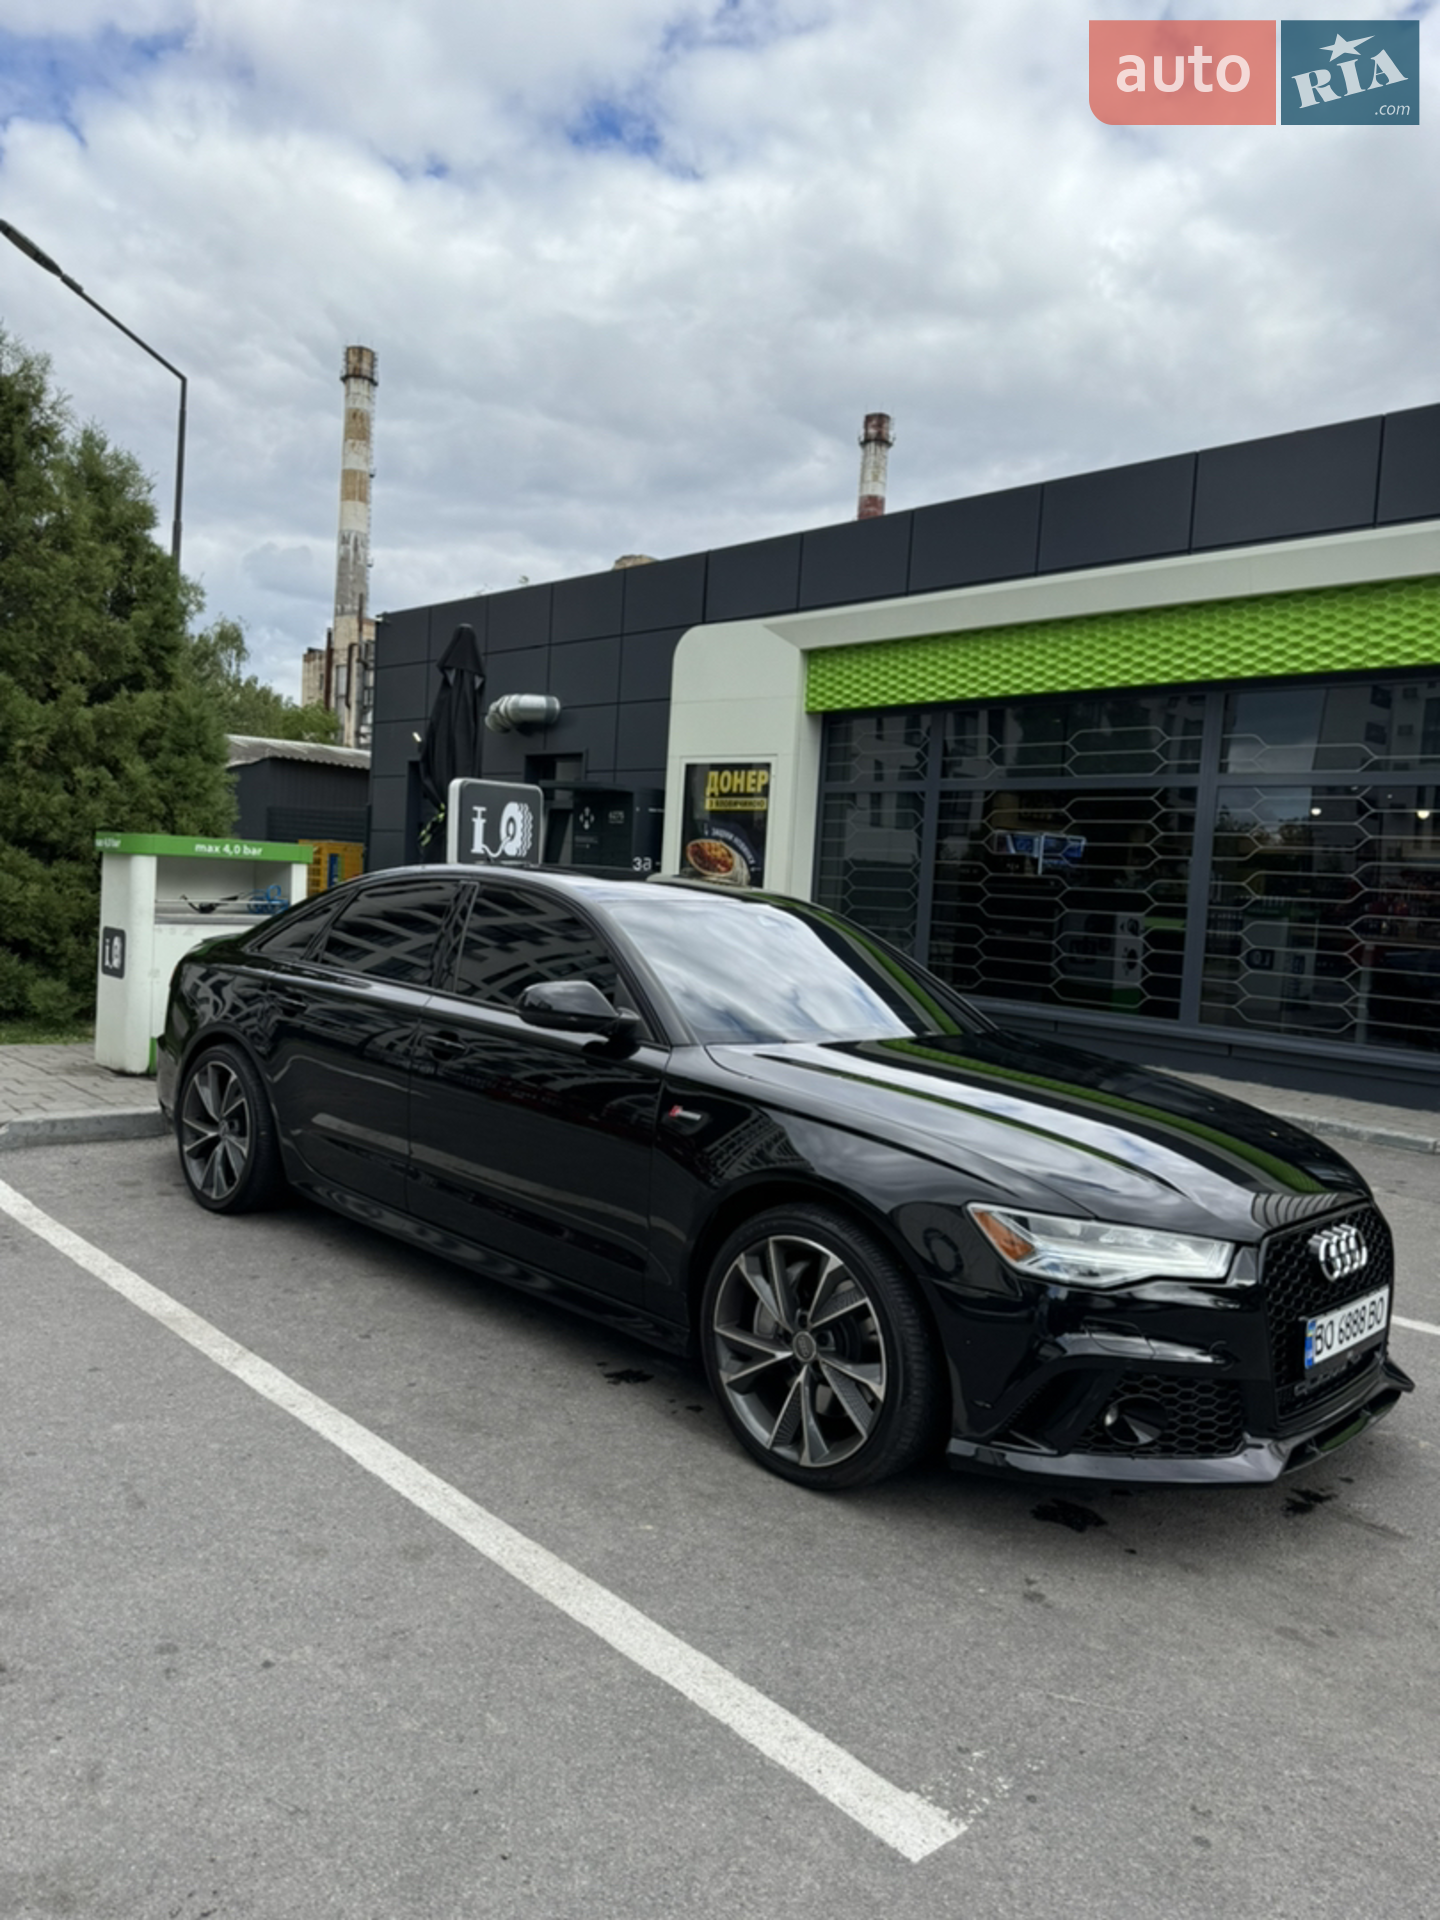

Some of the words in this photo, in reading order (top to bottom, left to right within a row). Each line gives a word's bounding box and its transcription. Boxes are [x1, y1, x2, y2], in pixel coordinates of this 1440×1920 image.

[705, 769, 769, 798] ДОНЕР
[195, 843, 220, 853] max
[222, 843, 241, 856] 4,0
[243, 844, 263, 856] bar
[1315, 1320, 1335, 1356] BO
[1368, 1297, 1385, 1331] BO
